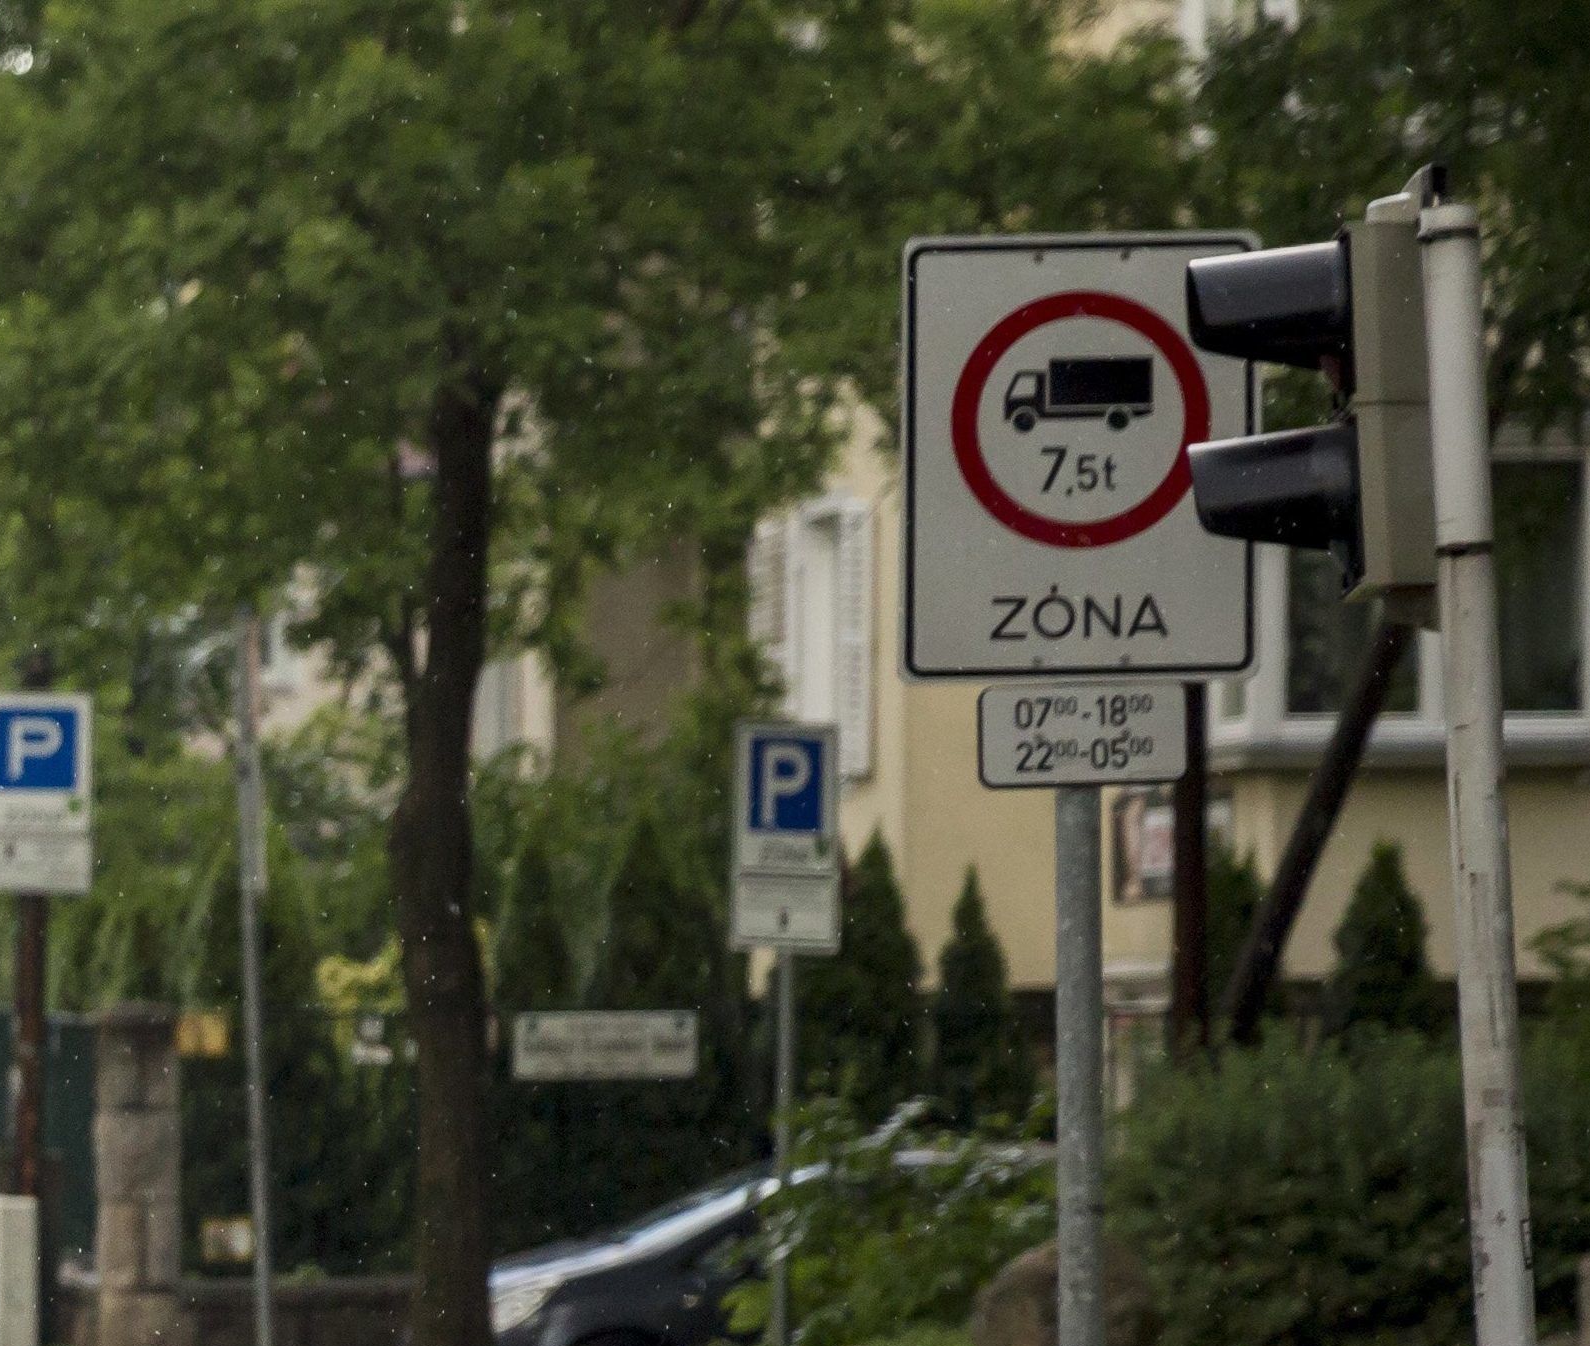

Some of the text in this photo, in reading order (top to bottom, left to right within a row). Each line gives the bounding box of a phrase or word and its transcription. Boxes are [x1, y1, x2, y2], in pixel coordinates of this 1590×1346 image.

[1040, 446, 1117, 497] 7,5t
[7, 716, 64, 781] P
[760, 743, 811, 829] P
